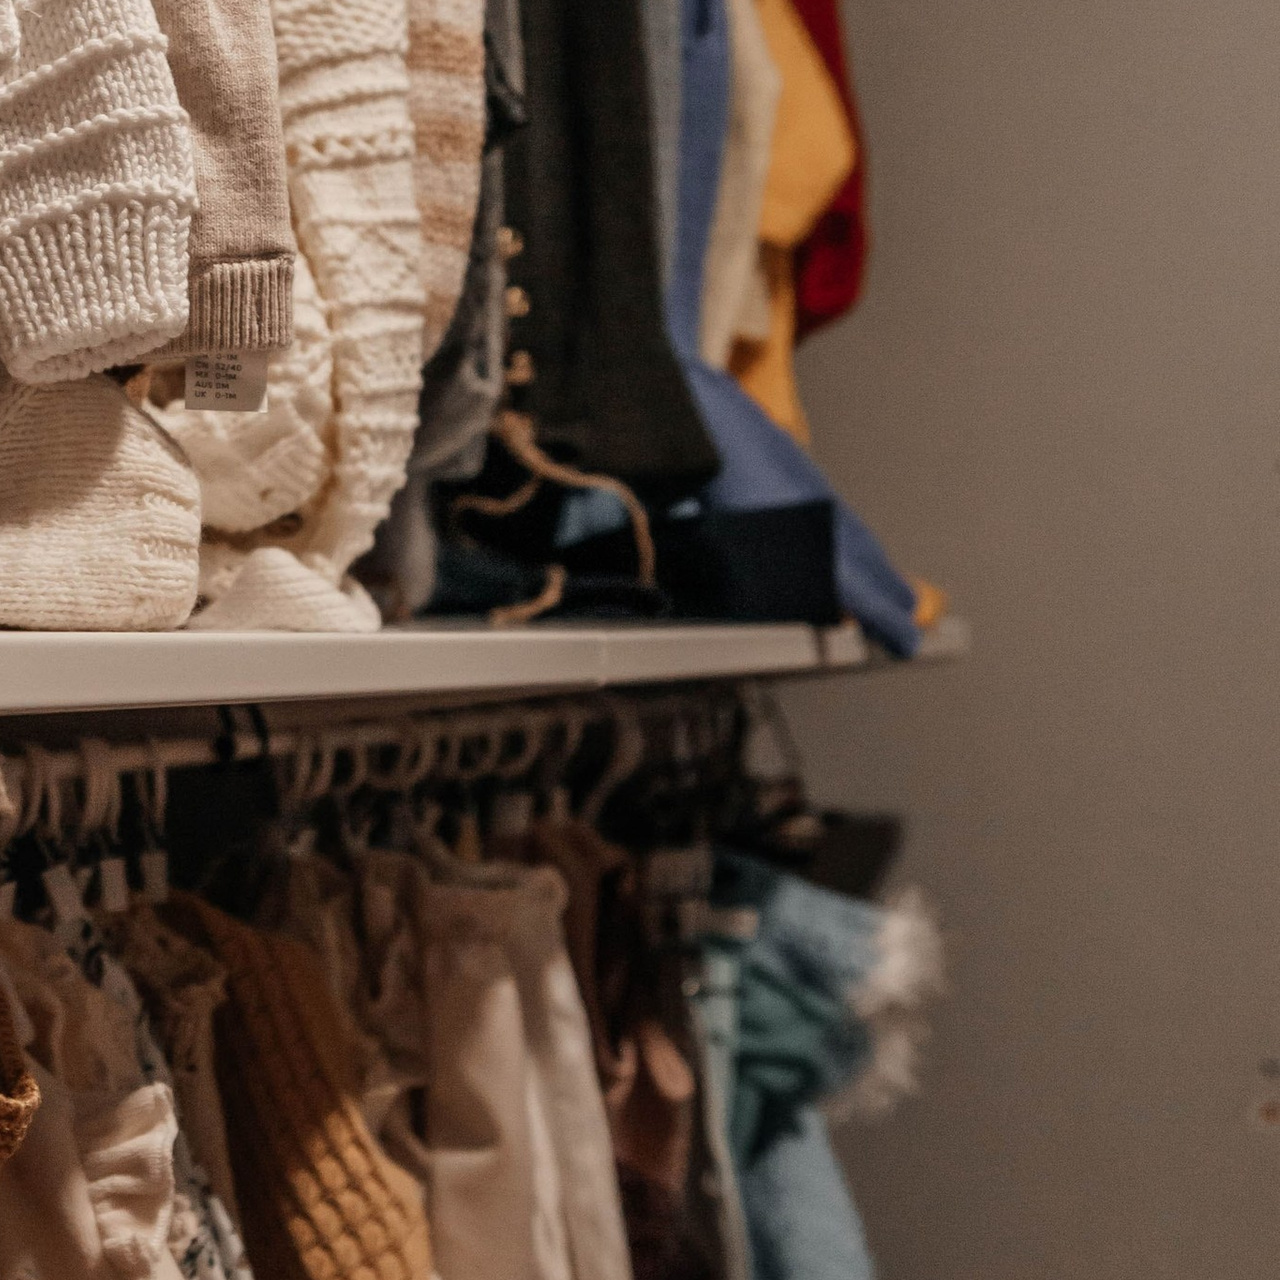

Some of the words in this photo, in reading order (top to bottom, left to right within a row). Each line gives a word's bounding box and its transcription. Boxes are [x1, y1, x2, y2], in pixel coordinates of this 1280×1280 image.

[215, 363, 242, 371] 52/40
[195, 381, 213, 389] AUS
[215, 391, 237, 399] 0-1M
